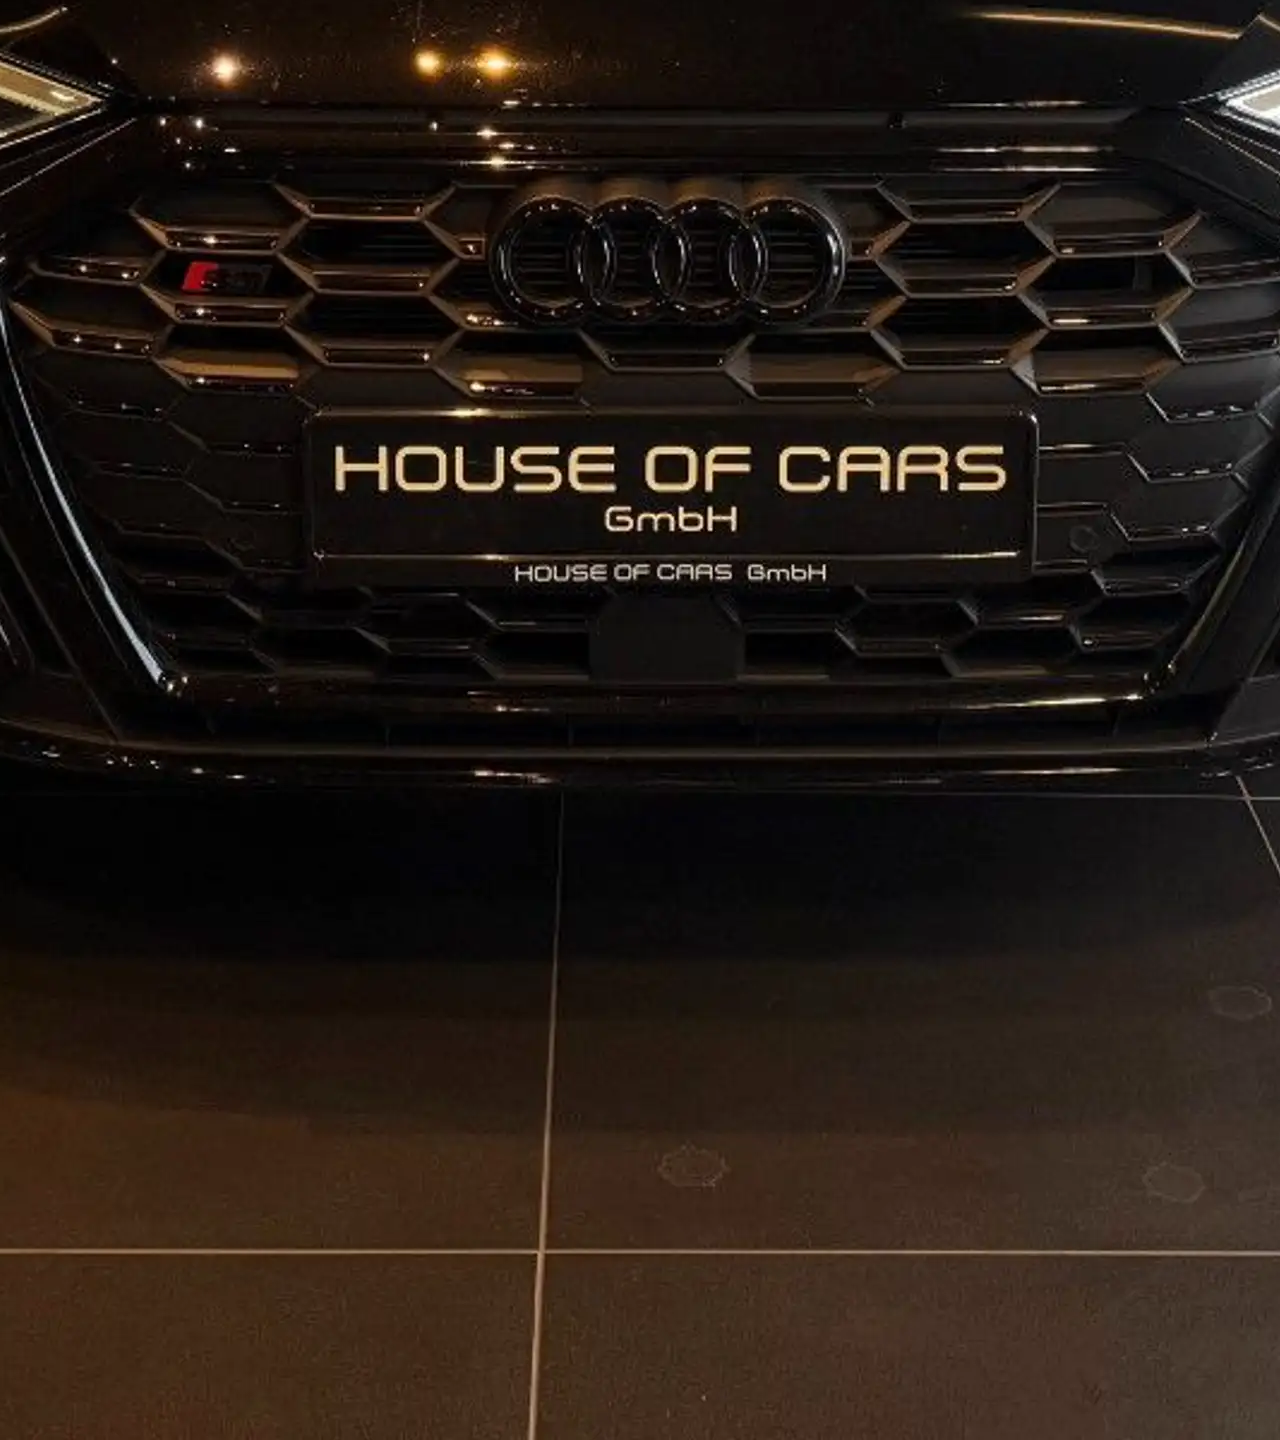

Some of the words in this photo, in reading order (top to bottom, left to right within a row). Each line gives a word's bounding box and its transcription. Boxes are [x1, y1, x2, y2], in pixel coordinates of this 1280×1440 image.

[335, 446, 617, 493] HOUSE
[645, 446, 752, 493] OF
[778, 446, 1007, 493] CARS
[604, 505, 737, 532] GmbH
[514, 563, 608, 583] HOUSE
[613, 563, 651, 582] OF
[656, 563, 733, 582] CARS
[747, 563, 827, 582] GmbH
